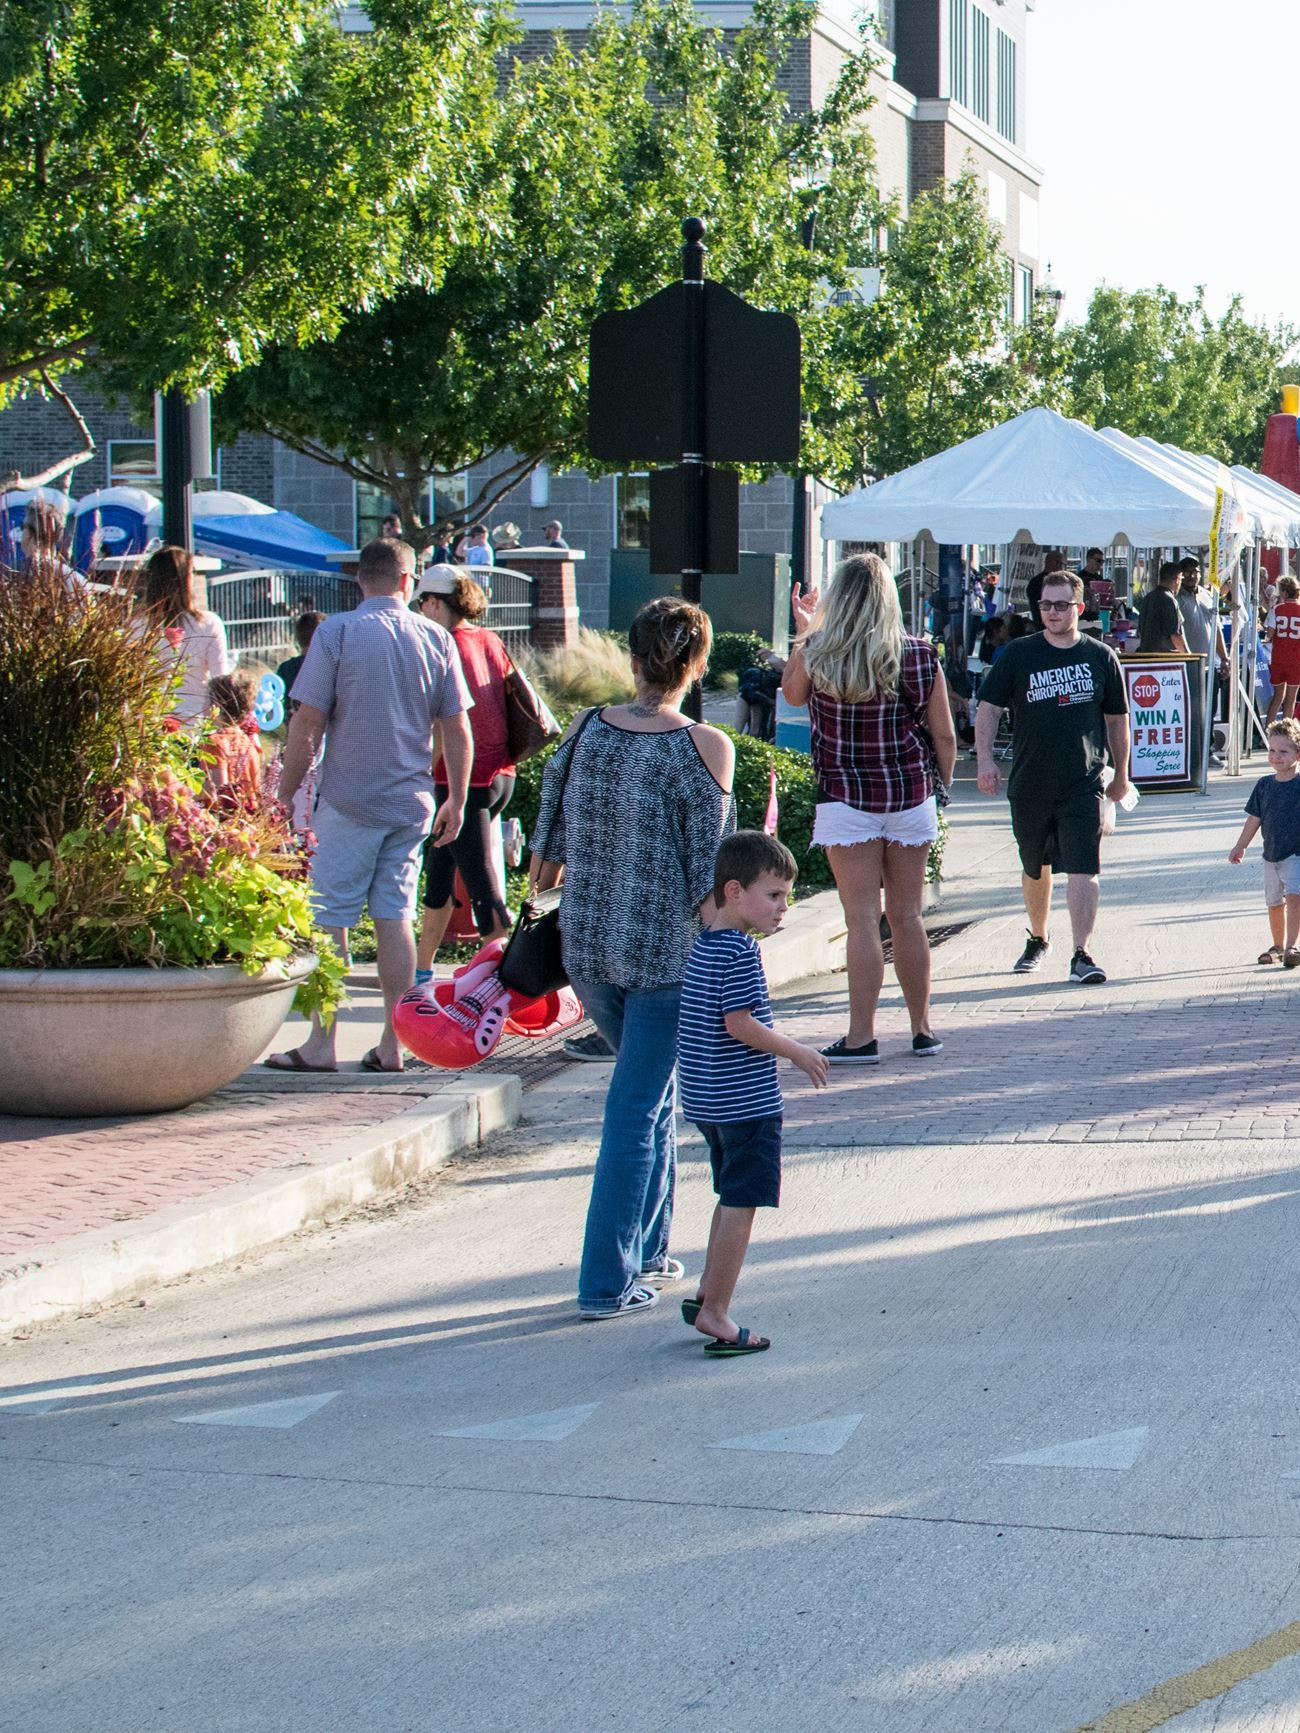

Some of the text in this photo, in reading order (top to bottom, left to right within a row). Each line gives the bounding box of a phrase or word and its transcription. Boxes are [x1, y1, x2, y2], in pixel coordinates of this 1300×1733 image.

[1029, 663, 1092, 689] AMERICA'S
[1161, 677, 1181, 687] Enter
[1026, 679, 1094, 703] CHIROPRACTOR
[1134, 685, 1159, 698] STOP
[1174, 693, 1182, 701] to
[1135, 709, 1181, 726] WIN A
[1133, 727, 1184, 745] FREE
[1137, 748, 1181, 760] Shopping
[1155, 761, 1181, 772] Spree
